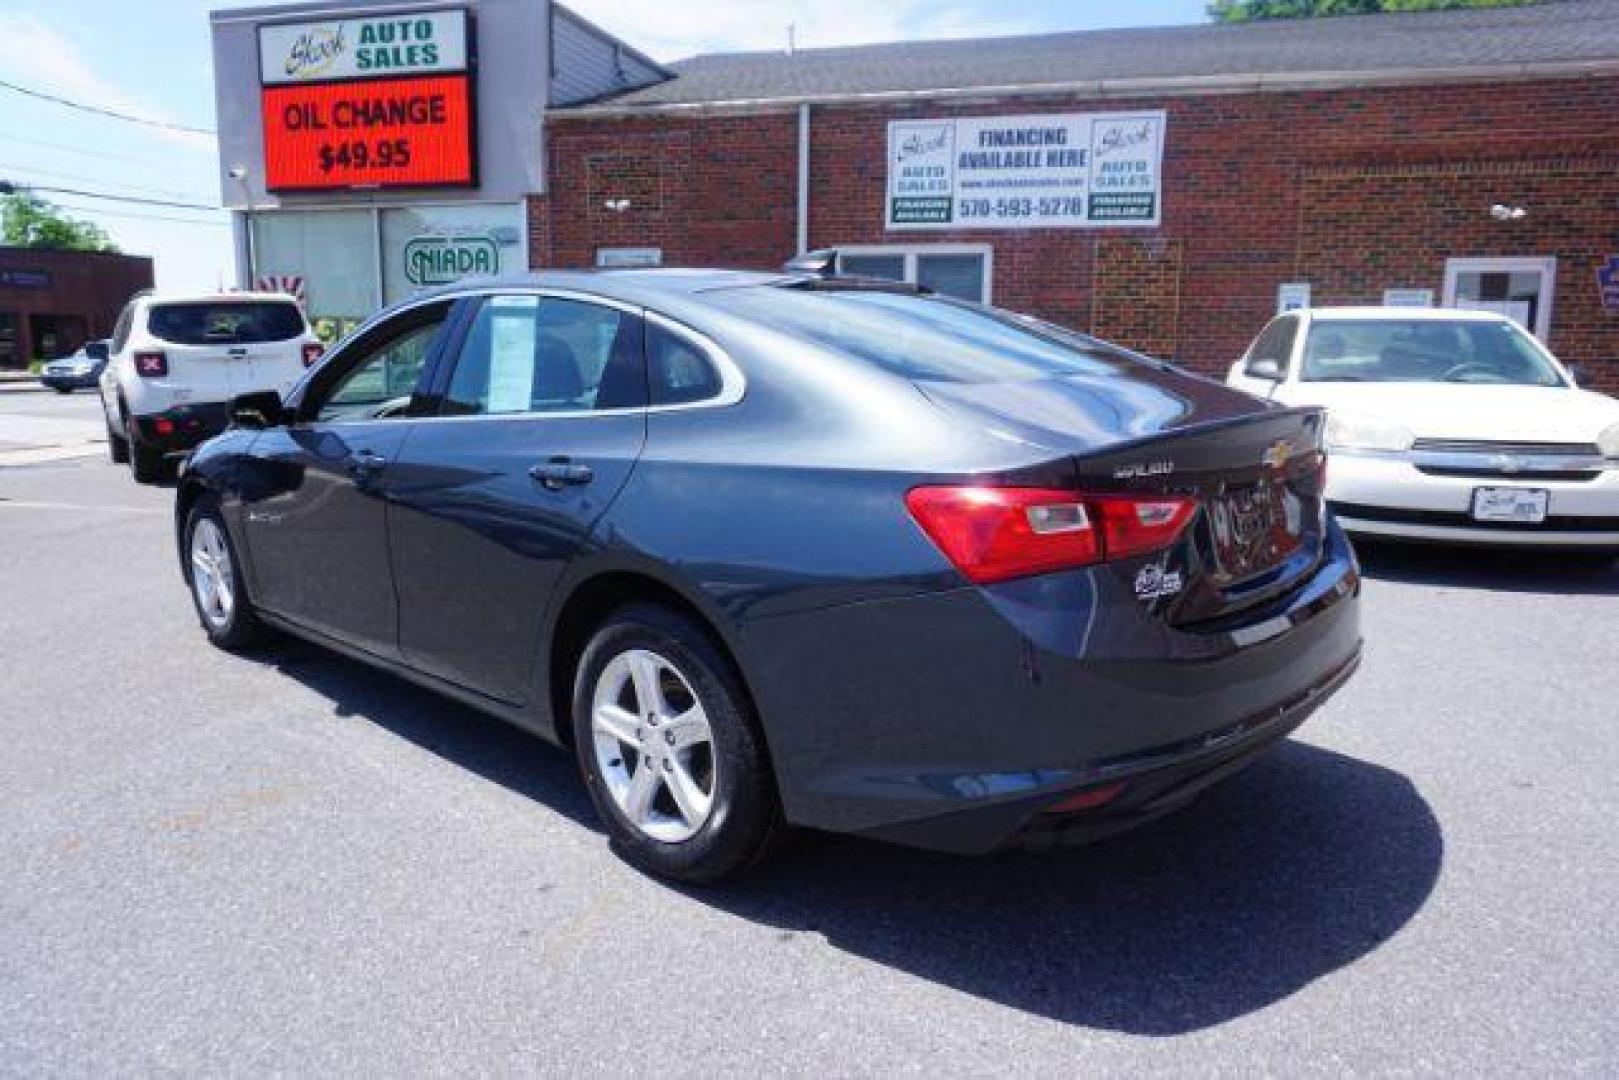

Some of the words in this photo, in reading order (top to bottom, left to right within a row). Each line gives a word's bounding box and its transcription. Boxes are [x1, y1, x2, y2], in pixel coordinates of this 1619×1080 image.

[359, 19, 433, 44] AUTO
[355, 43, 439, 70] SALES
[284, 102, 326, 131] OIL
[332, 95, 446, 129] CHANGE
[978, 128, 1068, 147] FINANCING
[319, 139, 411, 172] $49.95
[959, 151, 1041, 169] AVAILABLE
[1047, 149, 1088, 168] HERE
[902, 166, 945, 178] AUTO
[1100, 160, 1147, 173] AUTO
[897, 179, 948, 193] SALES
[1094, 174, 1152, 188] SALES
[410, 247, 489, 282] NIADA
